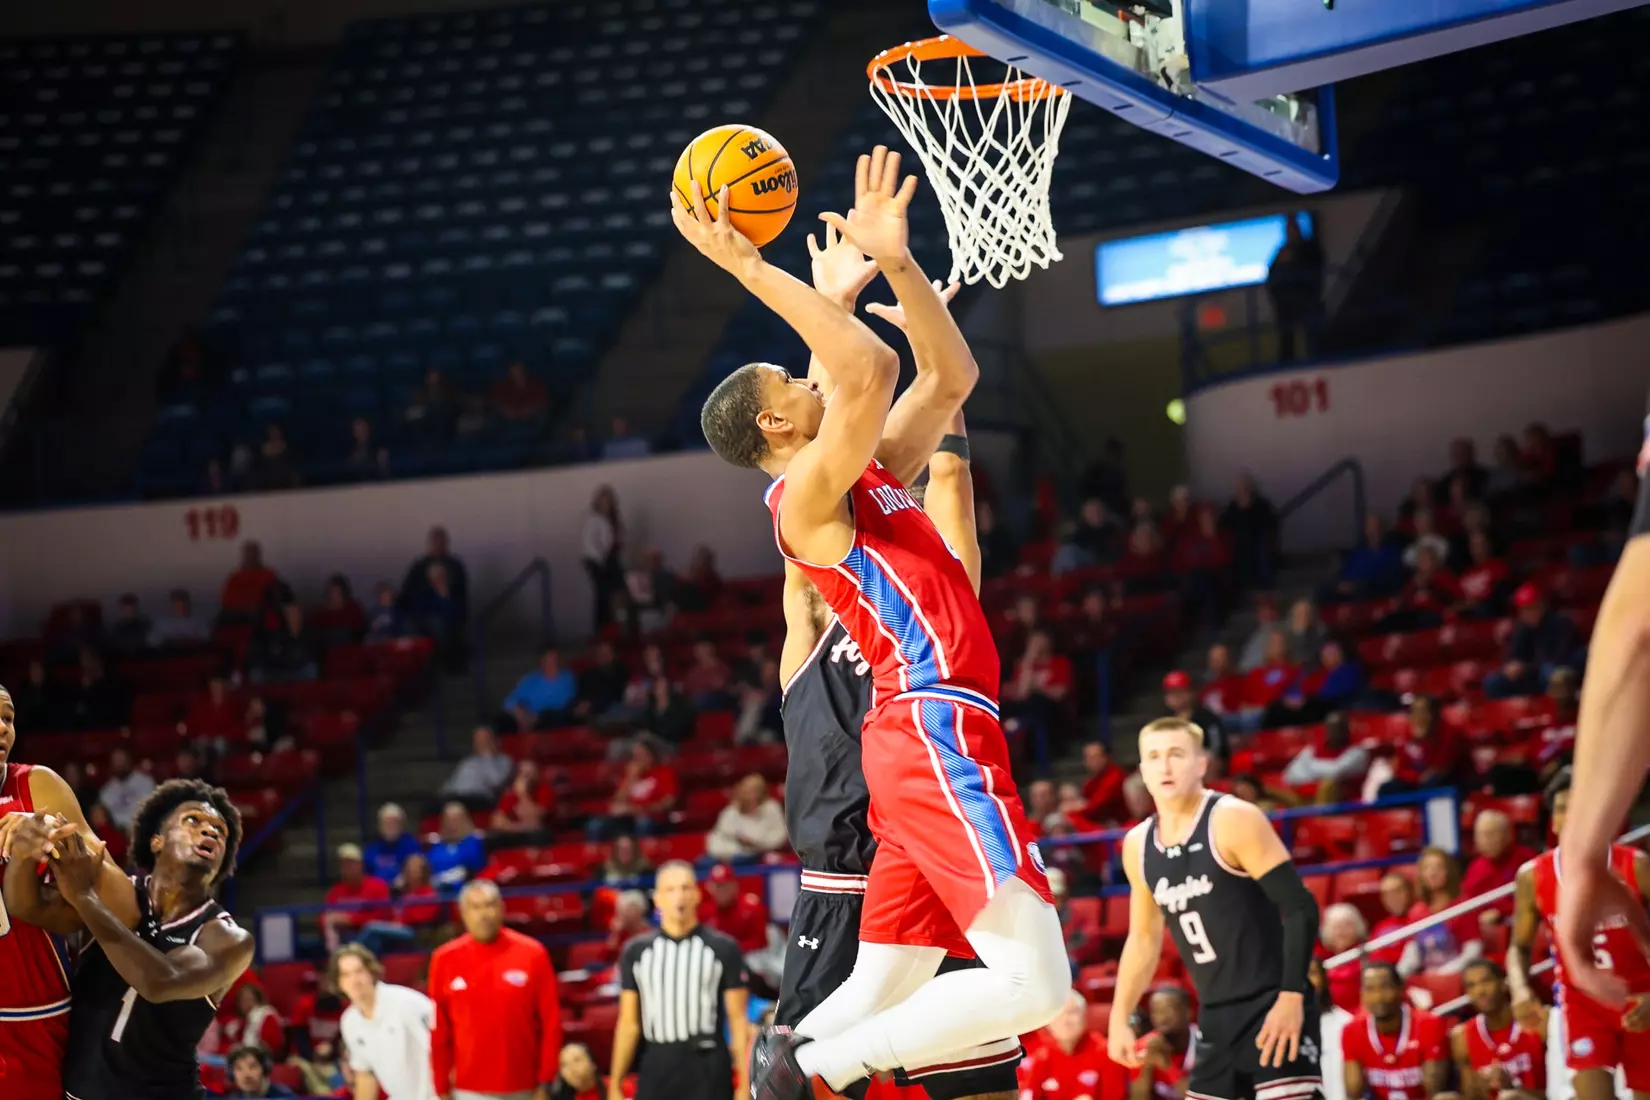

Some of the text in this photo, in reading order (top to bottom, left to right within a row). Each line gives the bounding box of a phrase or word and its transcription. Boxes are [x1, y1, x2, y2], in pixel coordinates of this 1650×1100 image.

[751, 169, 798, 196] ilson
[1269, 377, 1330, 418] 101
[184, 506, 240, 542] 119
[1153, 874, 1213, 914] Aggies
[1179, 911, 1217, 964] 9
[111, 986, 138, 1043] 1
